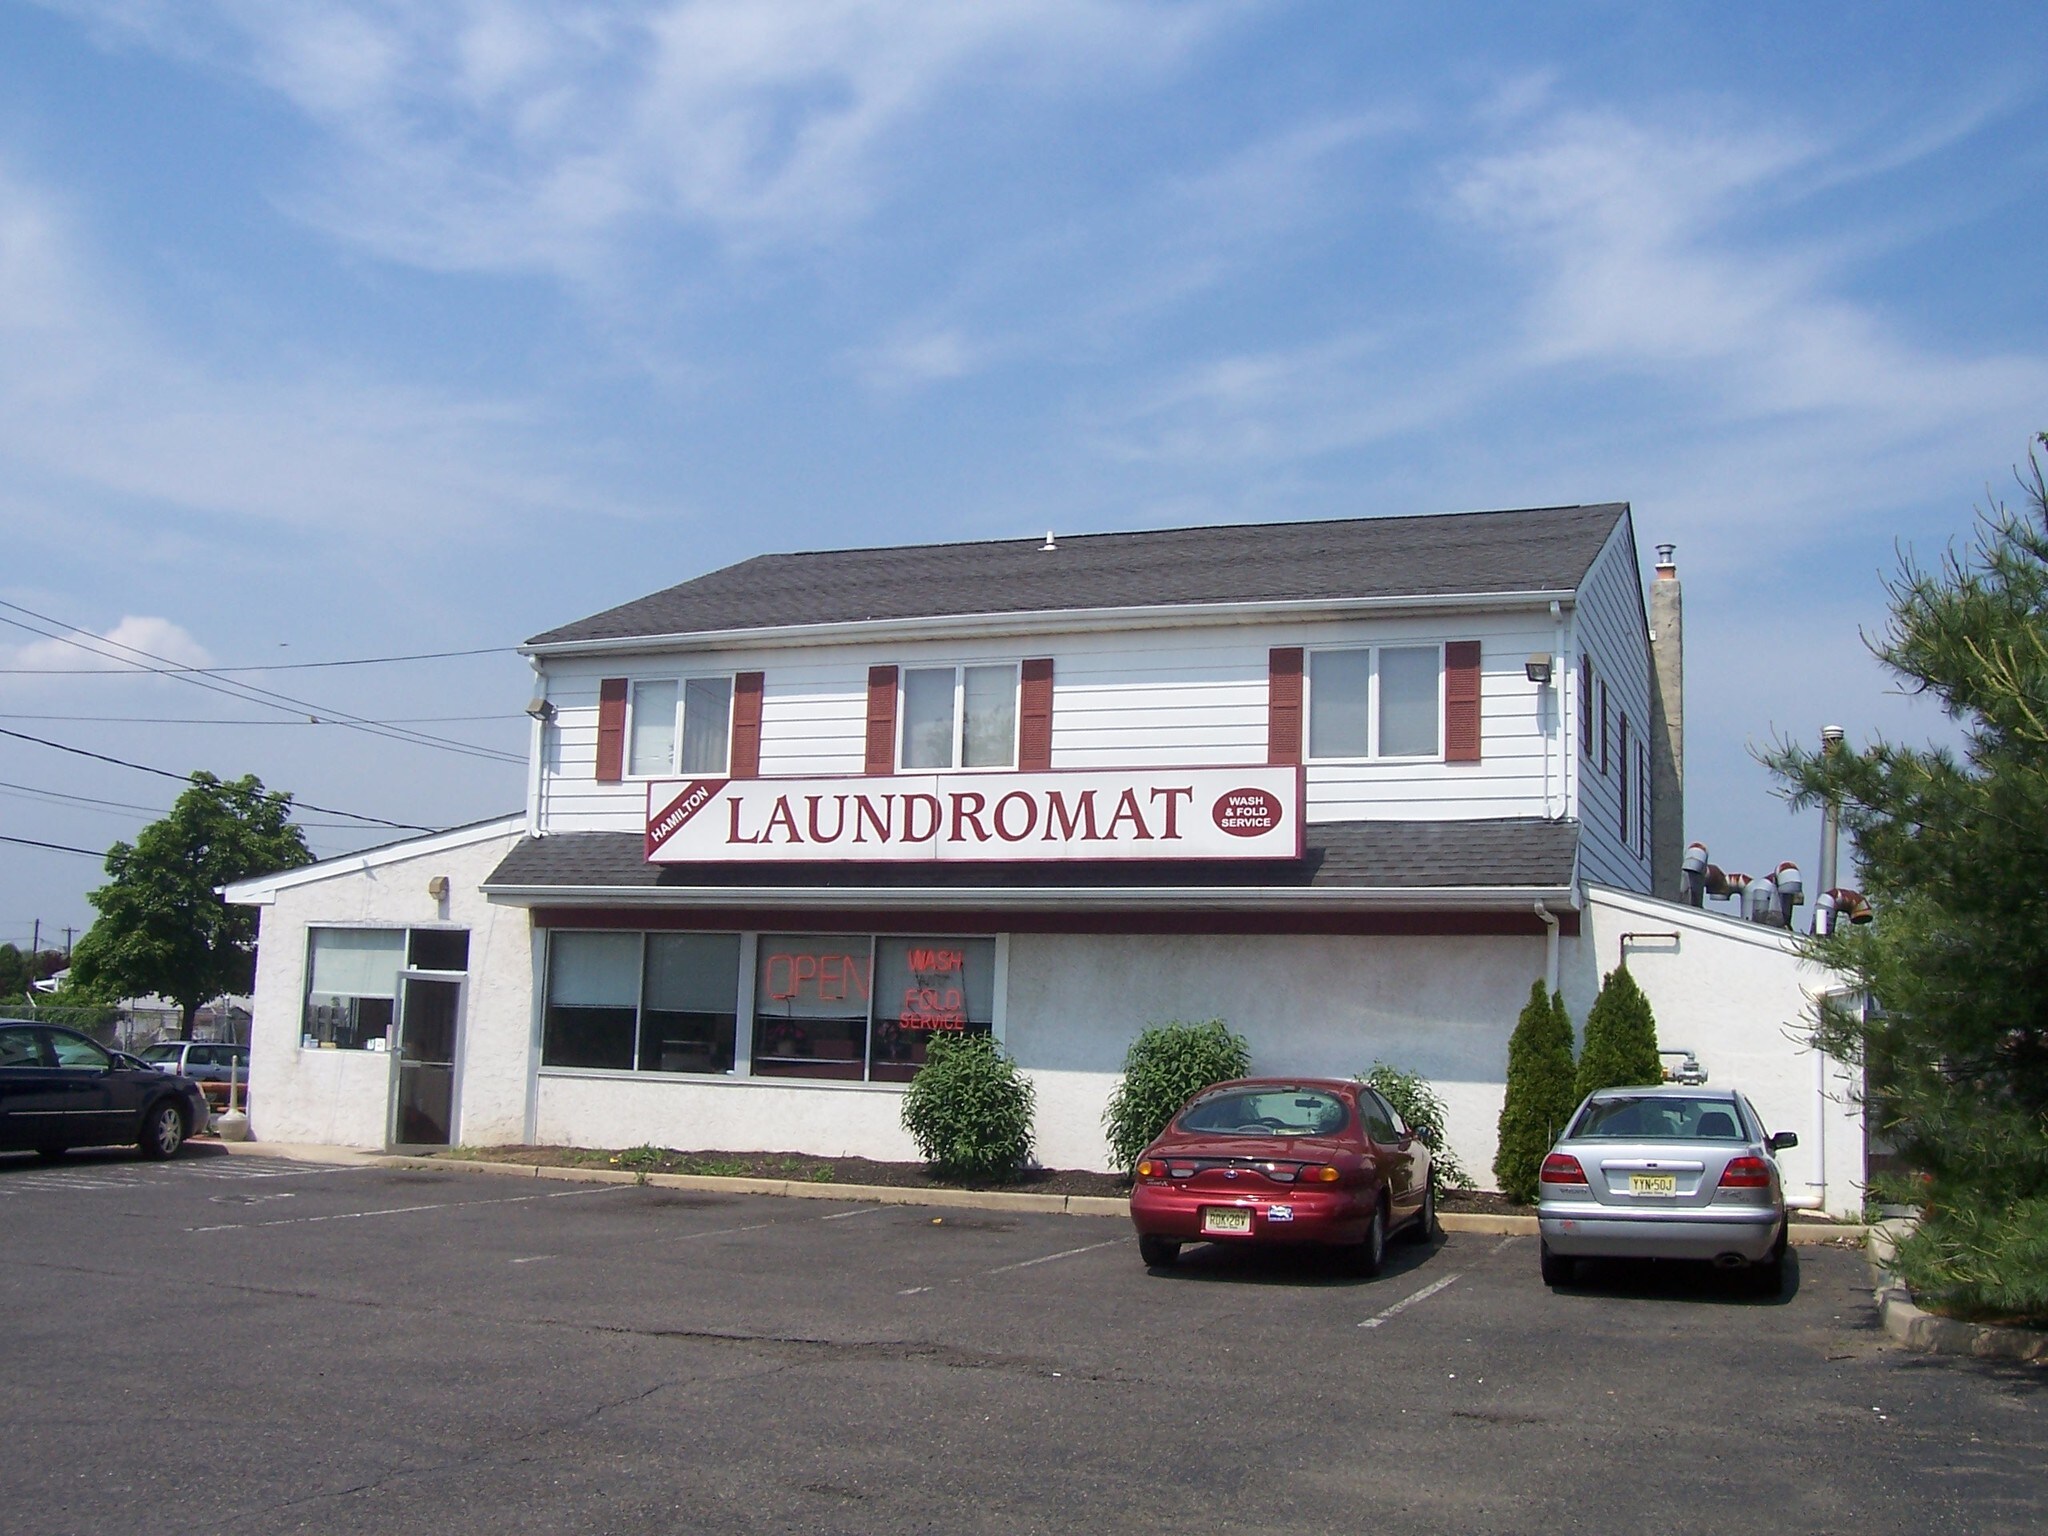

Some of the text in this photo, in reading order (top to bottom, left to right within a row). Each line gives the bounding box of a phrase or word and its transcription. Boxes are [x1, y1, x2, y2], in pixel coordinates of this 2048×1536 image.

[1225, 807, 1268, 817] & FOLD
[1229, 796, 1264, 806] WASH
[651, 786, 709, 842] HAMILTON
[725, 785, 1193, 845] LAUNDROMAT
[1221, 817, 1272, 828] SERVICE
[908, 950, 963, 972] WASH
[766, 953, 871, 1001] OPEN
[905, 987, 961, 1012] FOLD
[899, 1012, 965, 1031] SERVICE
